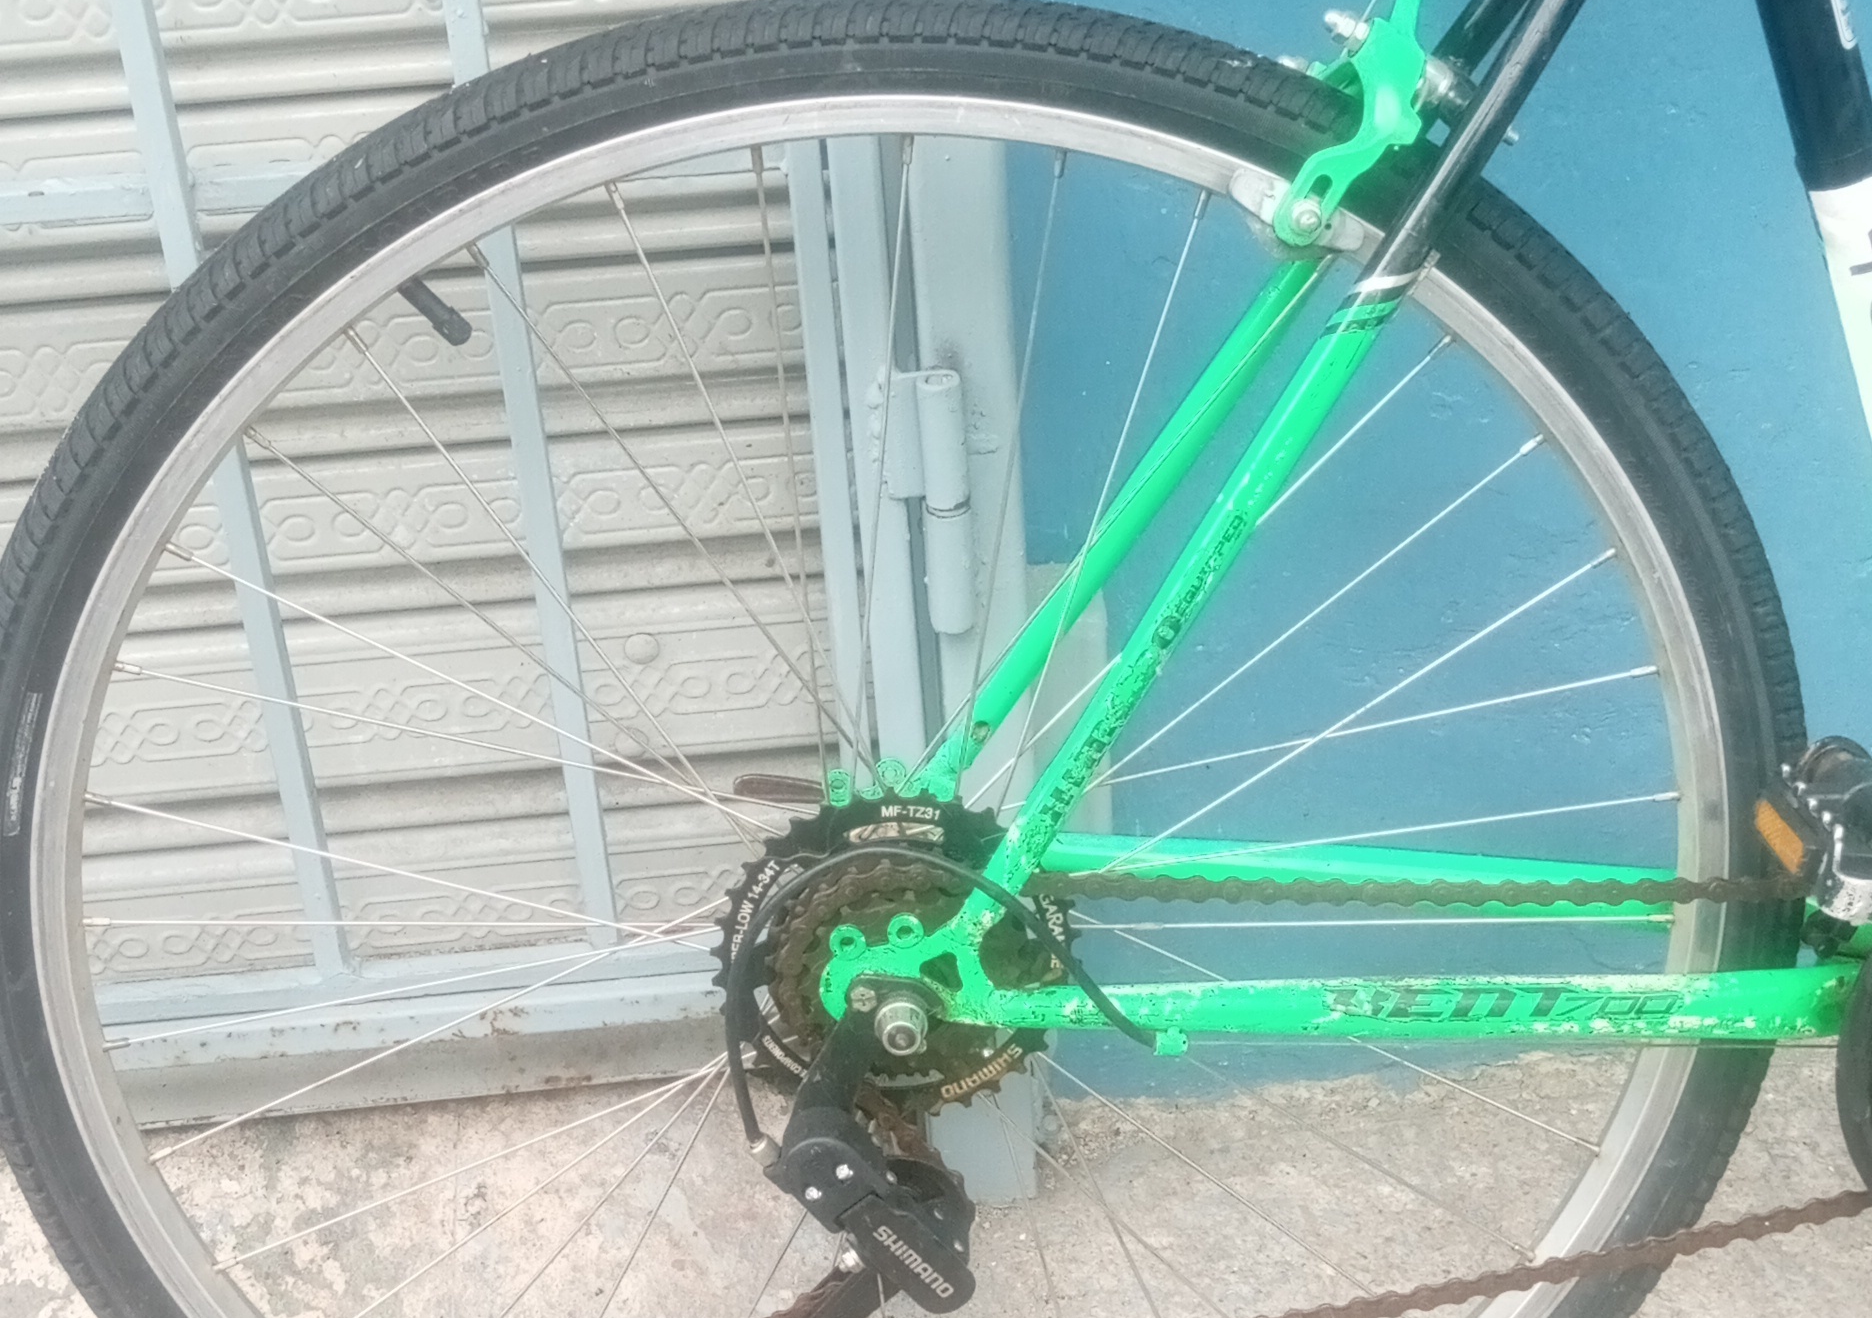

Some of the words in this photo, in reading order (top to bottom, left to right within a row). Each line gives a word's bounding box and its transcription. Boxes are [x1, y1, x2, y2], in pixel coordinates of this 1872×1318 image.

[880, 804, 941, 821] MF-TZ31
[747, 859, 781, 900] 14-34T
[940, 1042, 1024, 1099] SHIMANO
[872, 1225, 954, 1299] SHIMANO
